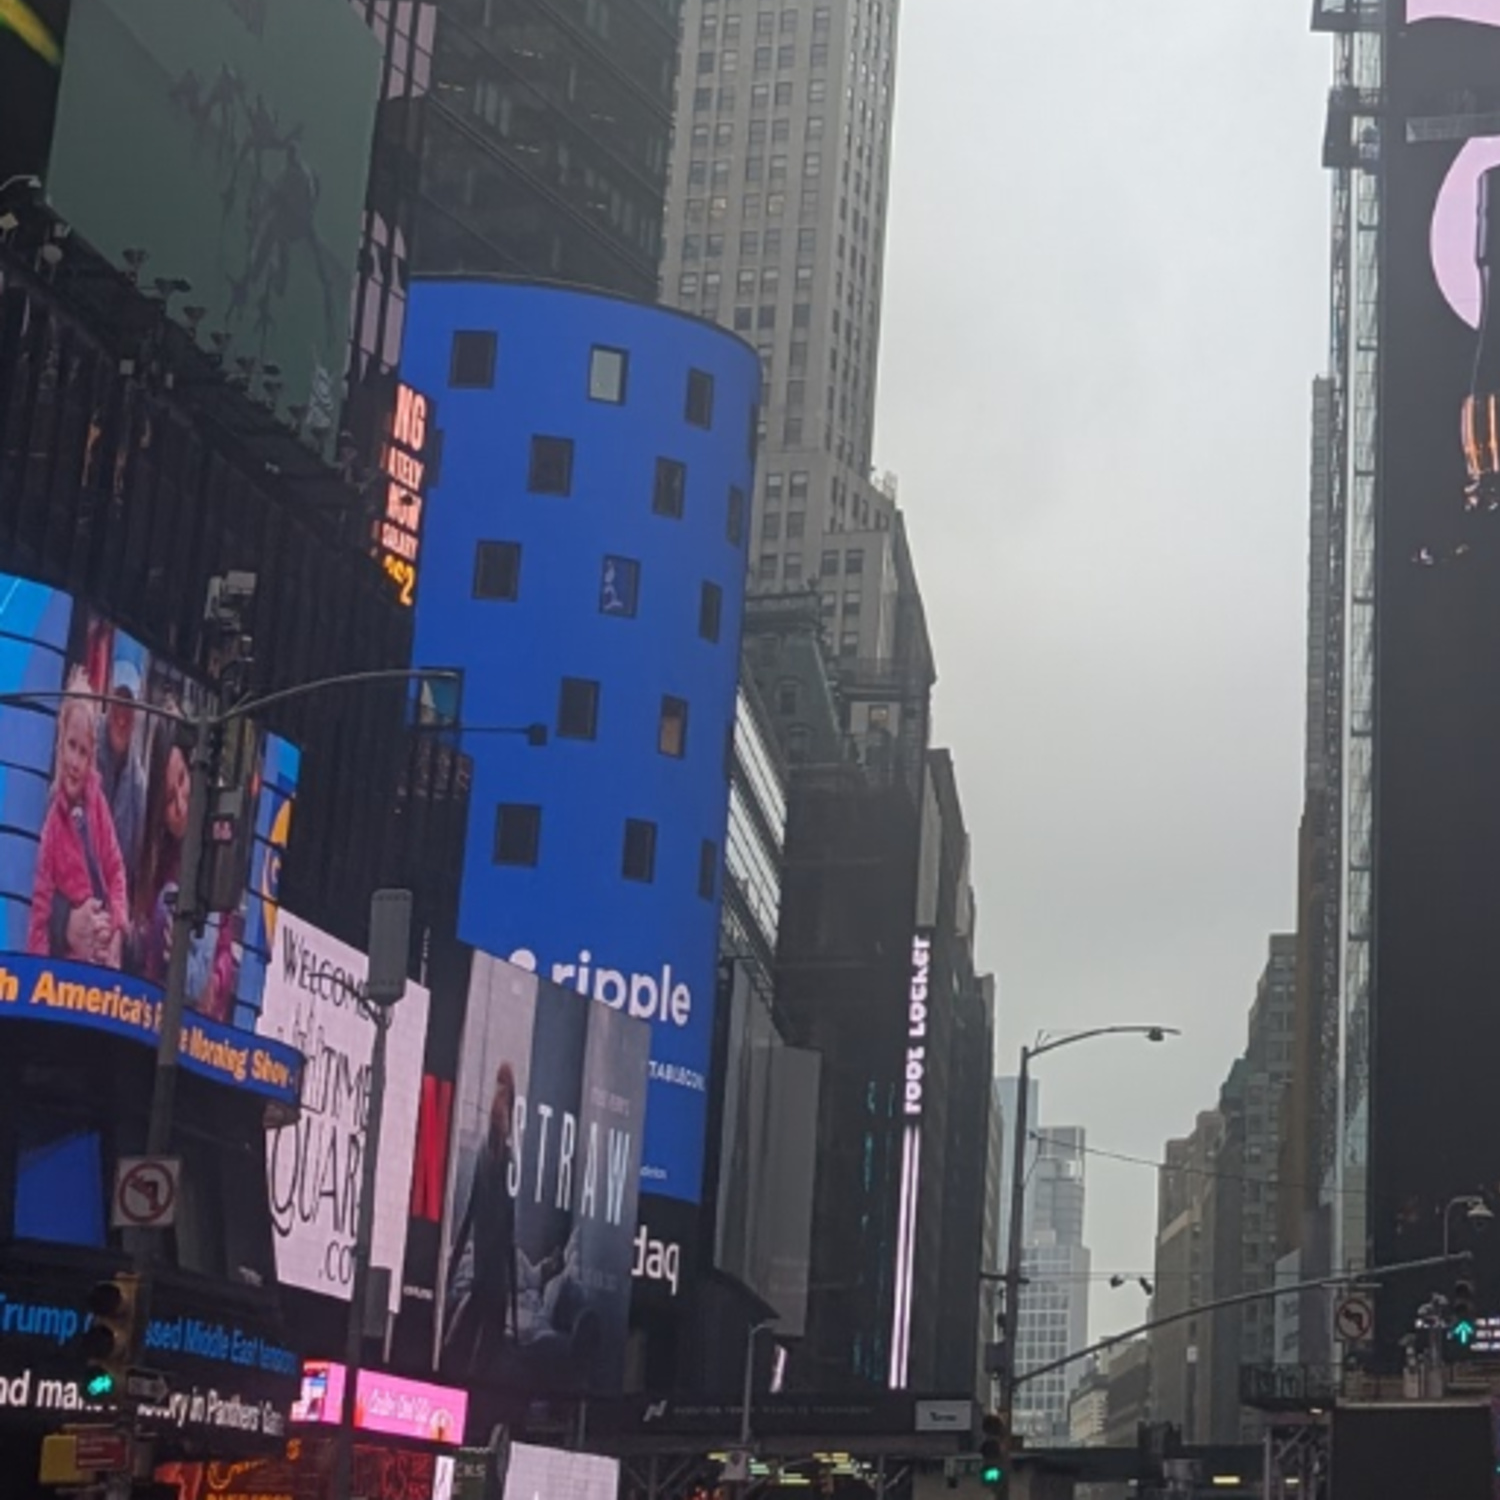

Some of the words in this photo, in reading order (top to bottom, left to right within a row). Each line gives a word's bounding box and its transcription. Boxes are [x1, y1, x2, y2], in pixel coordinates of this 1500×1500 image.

[30, 970, 153, 1031] America's
[551, 949, 692, 1027] ripple
[507, 1094, 631, 1227] STRAW
